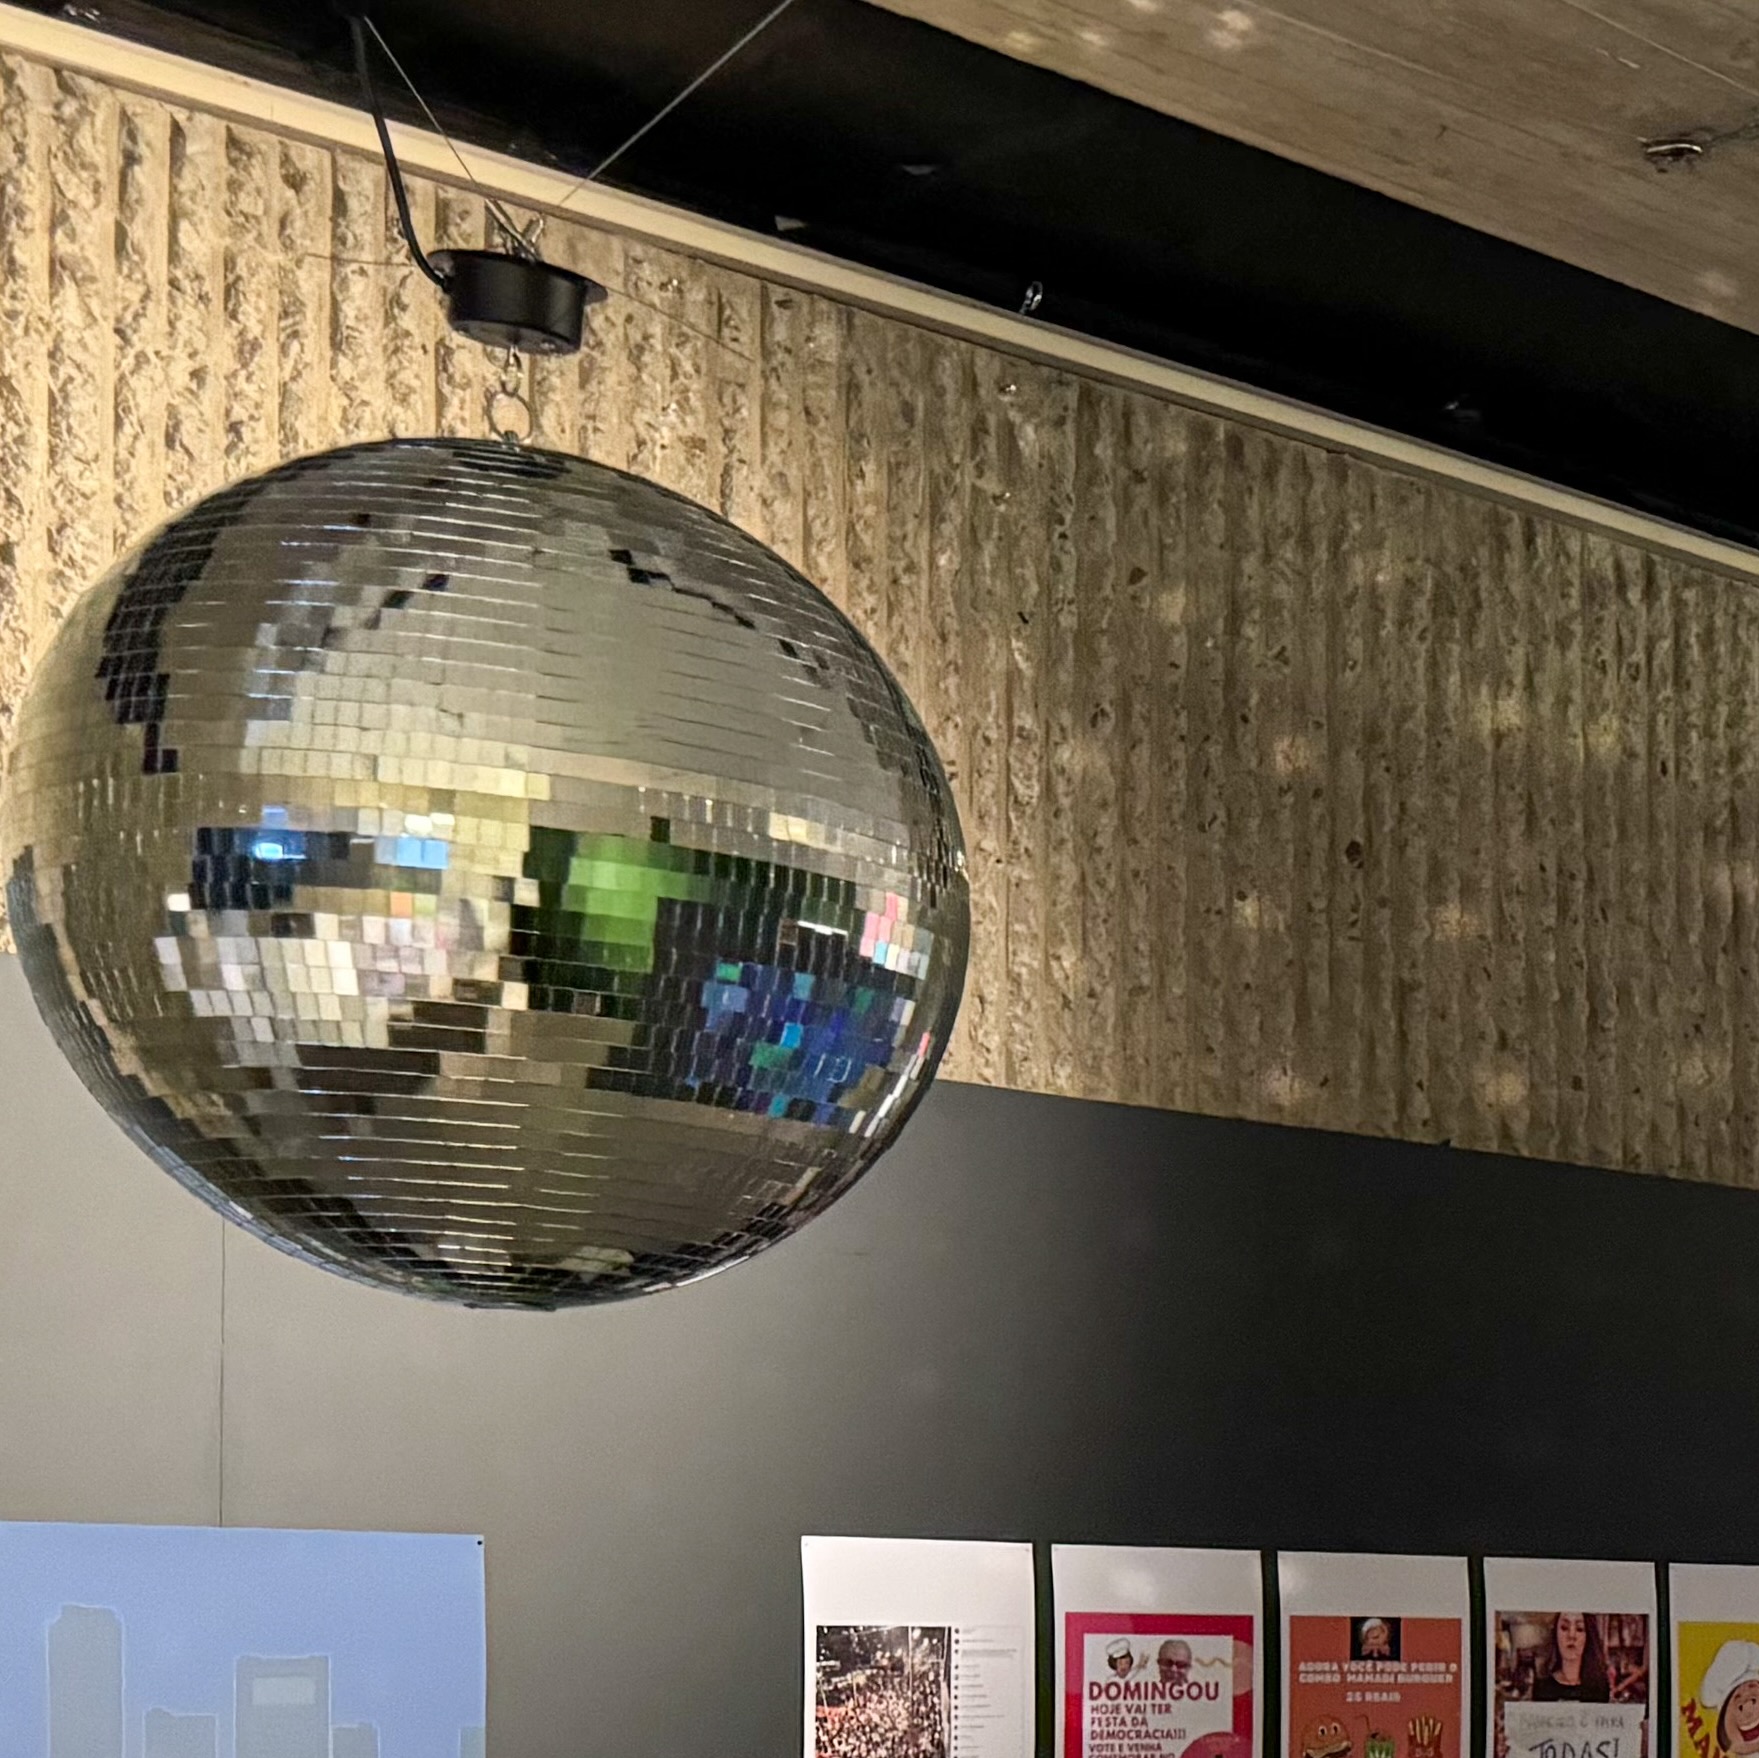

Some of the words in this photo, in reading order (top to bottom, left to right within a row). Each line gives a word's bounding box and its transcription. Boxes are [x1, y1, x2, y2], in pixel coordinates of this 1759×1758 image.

[1299, 1673, 1341, 1684] COMBO
[1088, 1681, 1220, 1701] DOMINGOU
[1090, 1704, 1121, 1715] HOJE
[1125, 1704, 1147, 1714] VAI
[1151, 1703, 1172, 1714] TER
[1090, 1716, 1127, 1728] FESTA
[1131, 1716, 1148, 1727] DA
[1089, 1743, 1115, 1753] VOTE
[1127, 1742, 1162, 1752] VENHA
